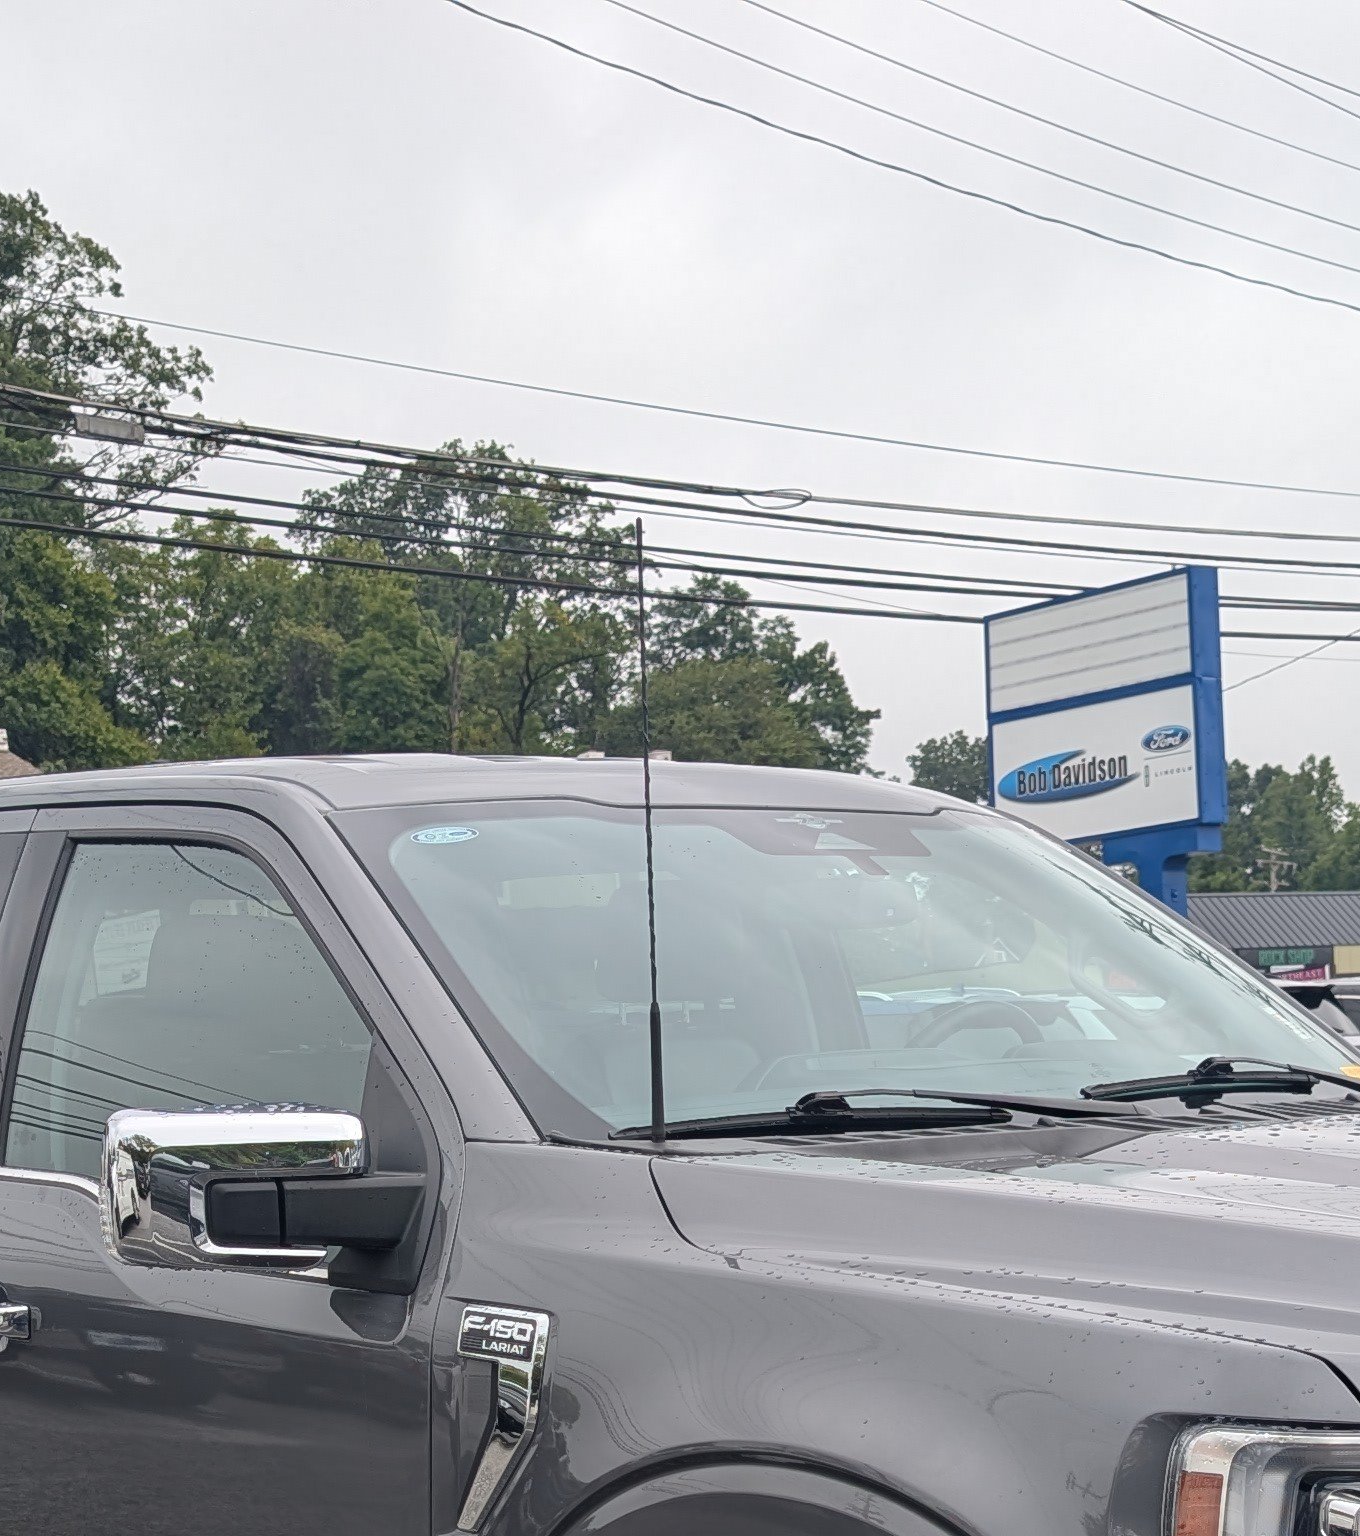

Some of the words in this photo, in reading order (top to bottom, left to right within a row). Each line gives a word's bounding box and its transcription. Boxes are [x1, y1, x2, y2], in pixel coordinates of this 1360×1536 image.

[1149, 728, 1184, 750] Ford
[1017, 766, 1047, 796] Bob
[1051, 754, 1129, 790] Davidson
[482, 1338, 527, 1356] LARIAT
